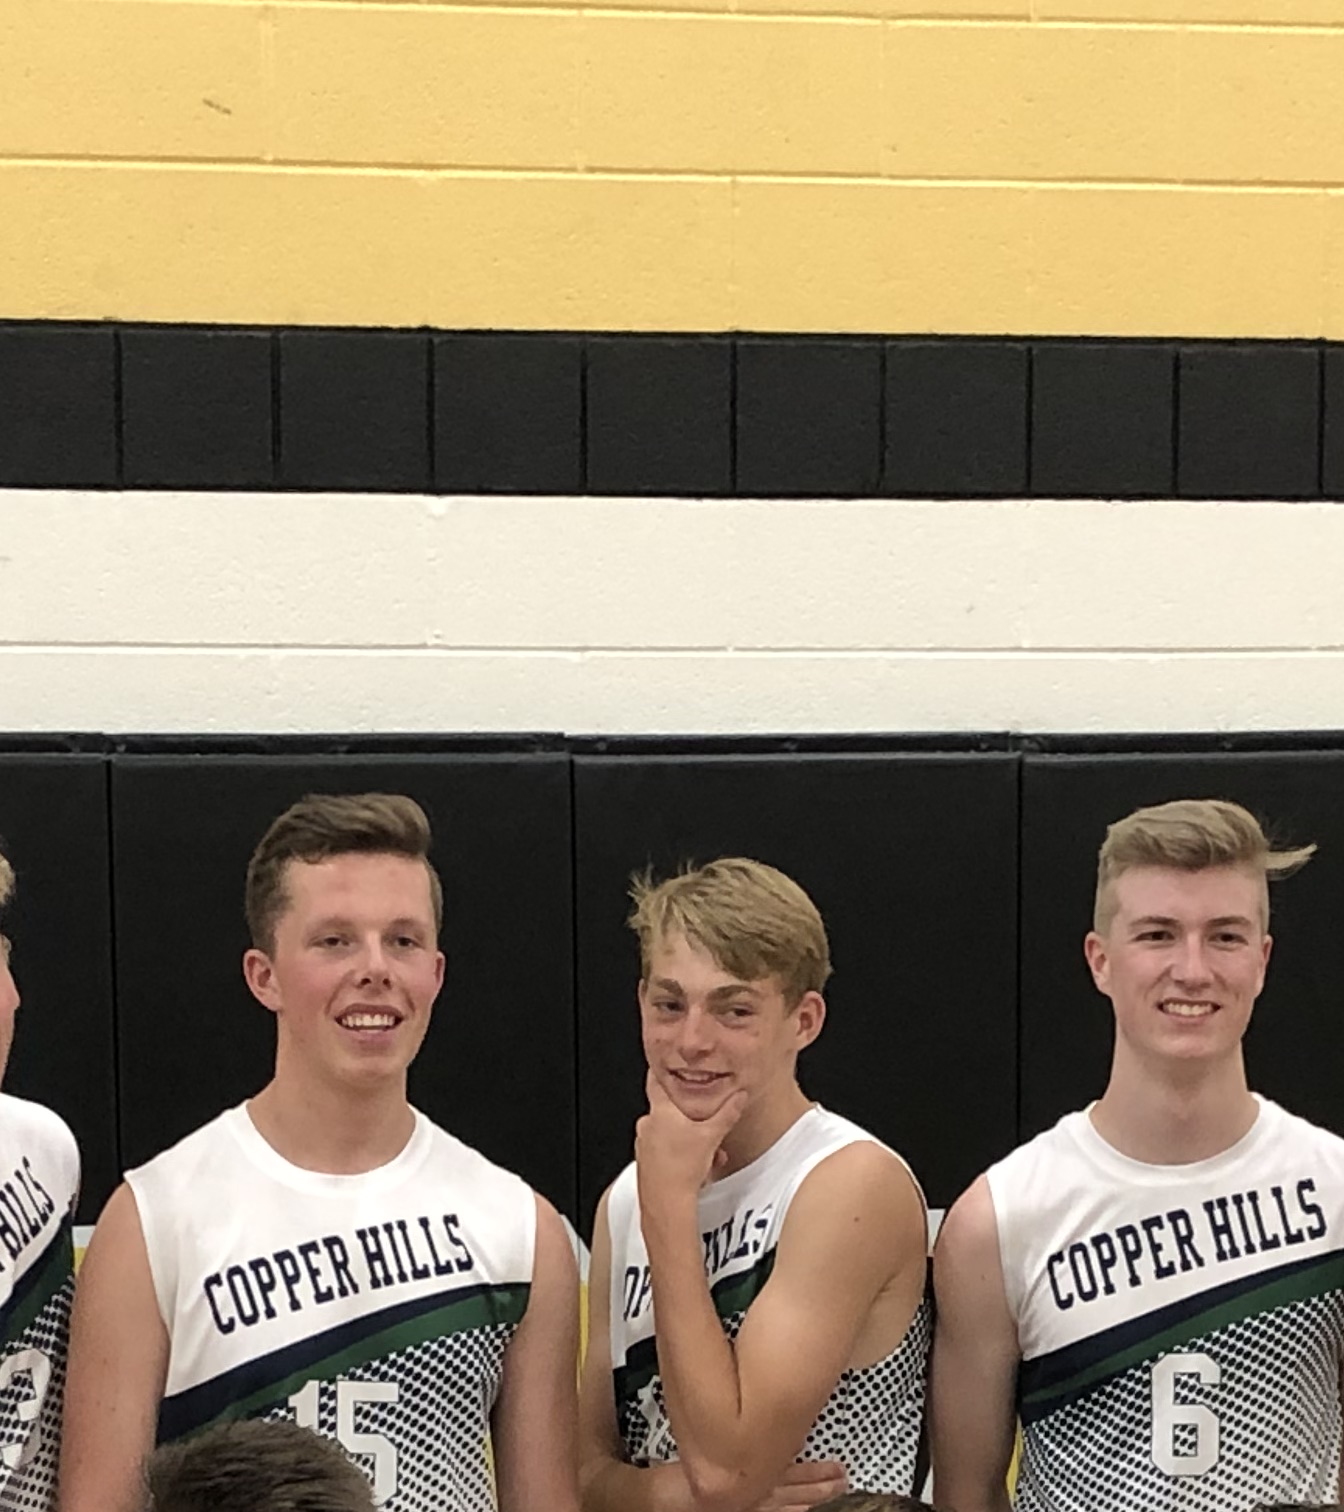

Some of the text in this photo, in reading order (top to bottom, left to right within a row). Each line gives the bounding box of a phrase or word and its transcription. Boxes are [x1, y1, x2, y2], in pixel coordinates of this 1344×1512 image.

[203, 1212, 475, 1336] COPPER HILLS
[1047, 1177, 1328, 1311] COPPER HILLS
[1150, 1352, 1222, 1478] 6
